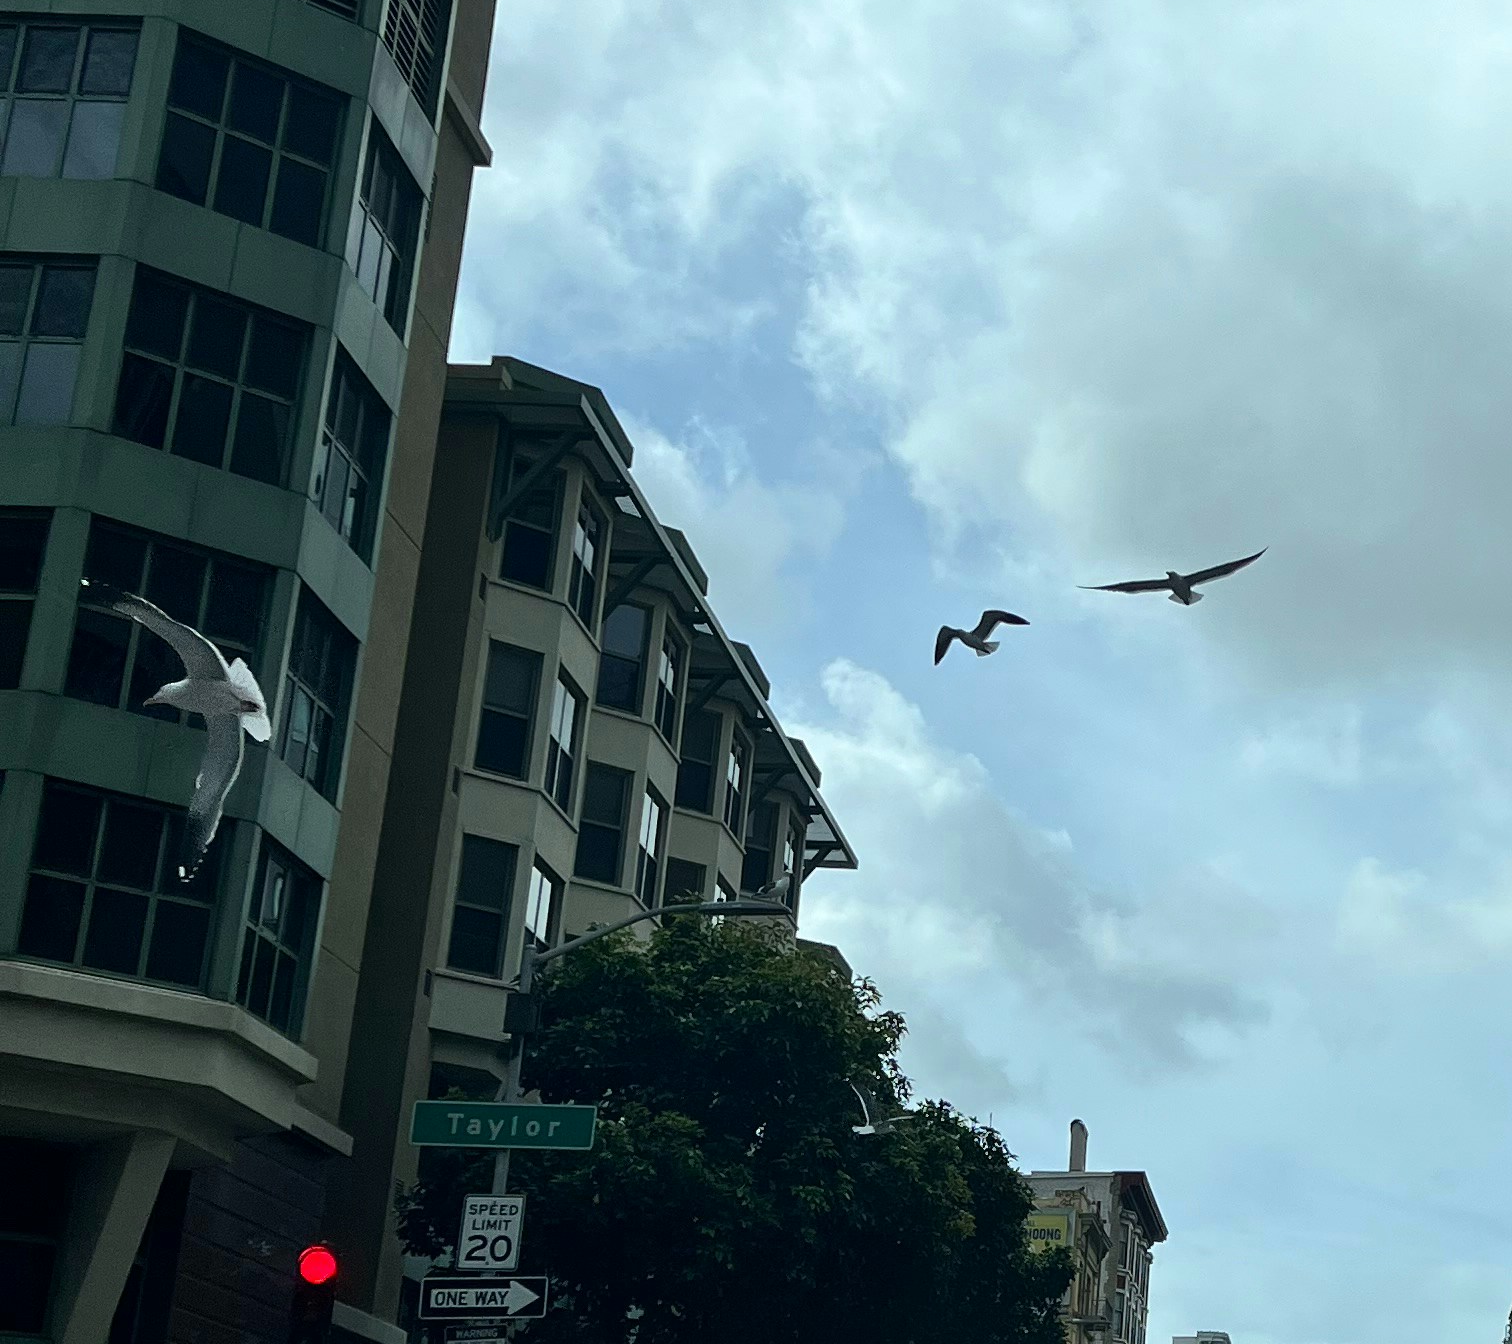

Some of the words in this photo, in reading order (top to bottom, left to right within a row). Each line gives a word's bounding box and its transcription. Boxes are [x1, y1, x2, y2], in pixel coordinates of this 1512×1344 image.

[447, 1113, 561, 1141] Taylor
[469, 1204, 519, 1216] SPEED
[472, 1219, 512, 1231] LIMIT
[464, 1234, 512, 1262] 20
[434, 1291, 468, 1306] ONE
[475, 1290, 509, 1306] WAY
[455, 1328, 498, 1338] WARNING
